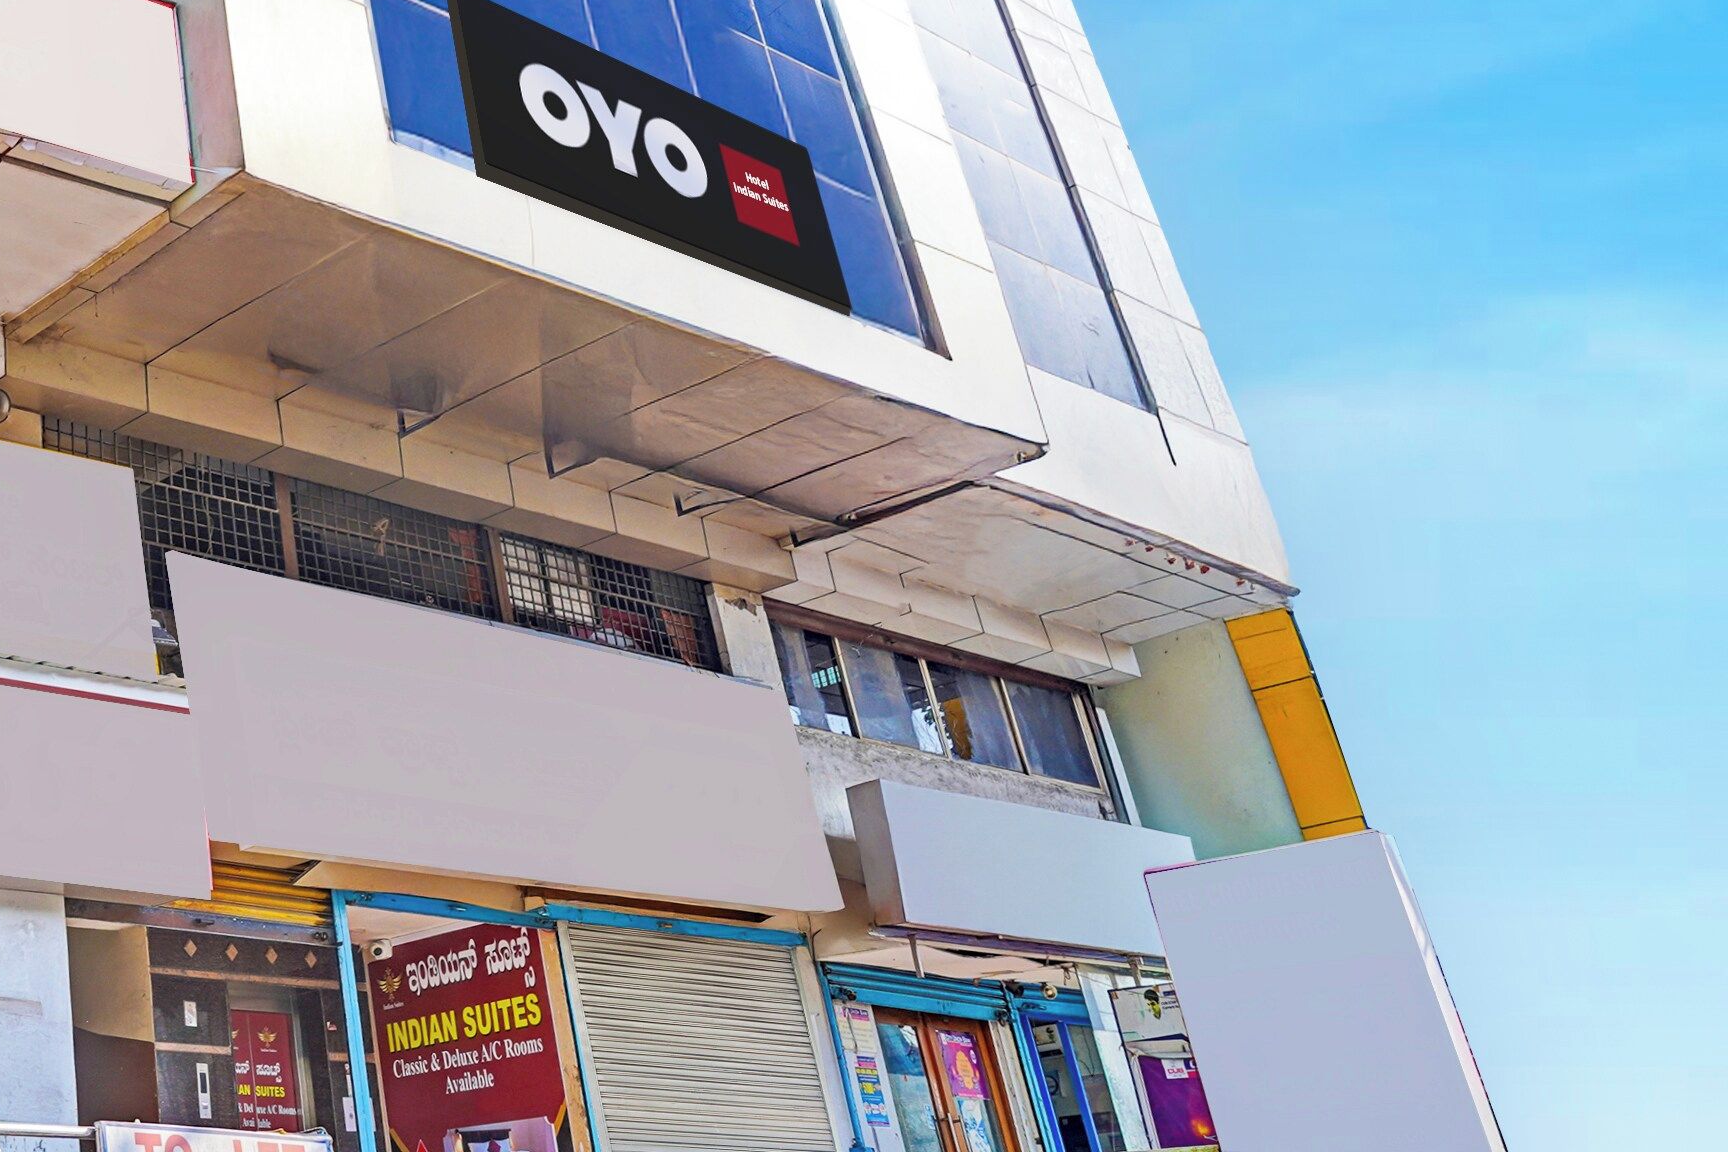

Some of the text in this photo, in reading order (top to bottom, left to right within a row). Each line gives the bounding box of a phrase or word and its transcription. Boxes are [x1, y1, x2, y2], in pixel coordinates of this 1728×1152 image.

[519, 63, 708, 198] OYO
[745, 172, 770, 190] Hotel
[733, 182, 789, 212] Indian Suites
[386, 993, 542, 1053] INDIAN SUITES
[393, 1037, 544, 1078] Classic & Deluxe A/C Rooms
[255, 1085, 286, 1098] SUITES
[446, 1069, 495, 1094] Available
